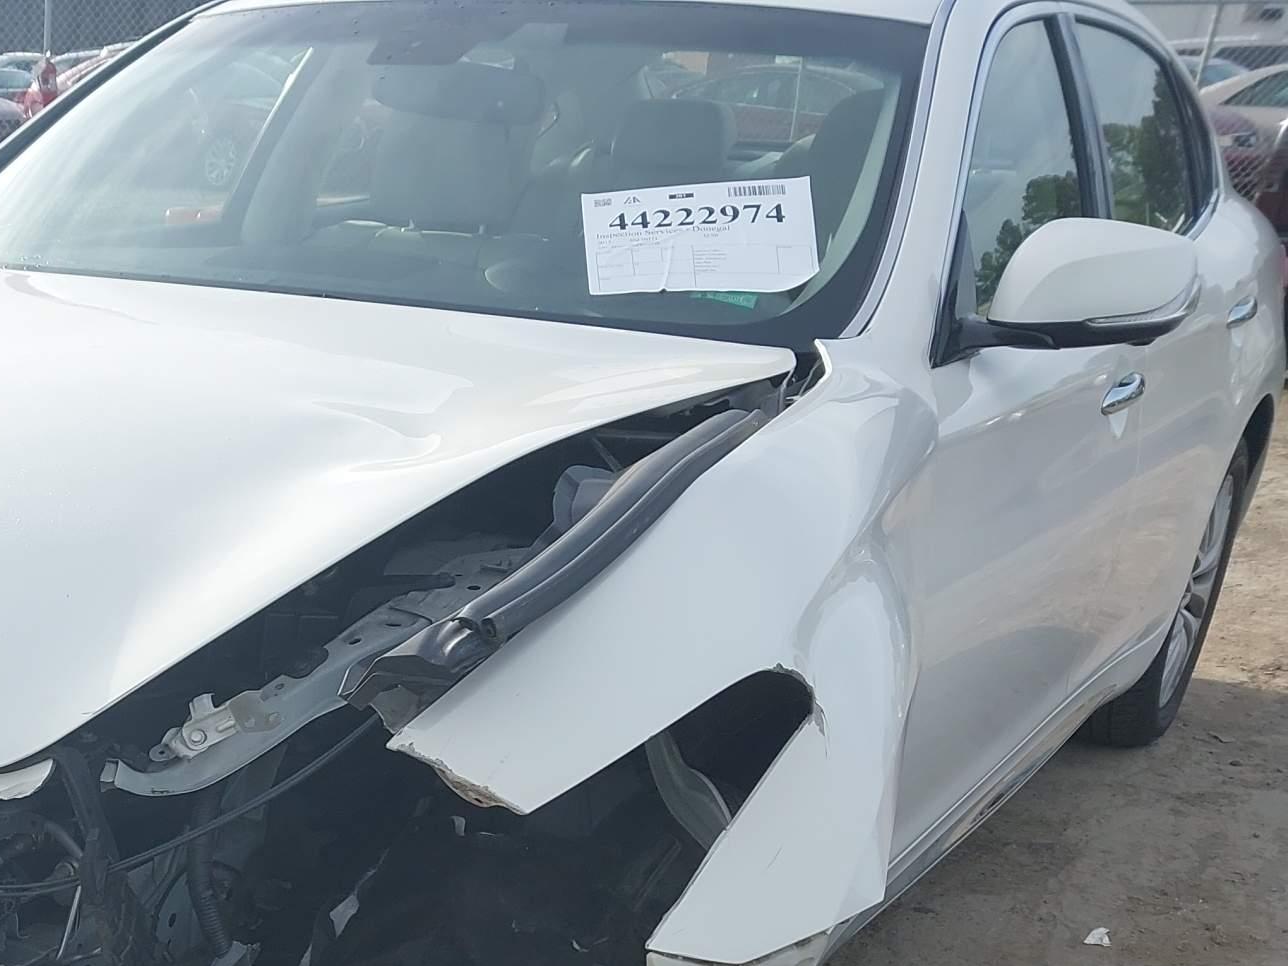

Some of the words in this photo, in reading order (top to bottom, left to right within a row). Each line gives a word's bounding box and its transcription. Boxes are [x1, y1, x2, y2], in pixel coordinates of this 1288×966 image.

[609, 203, 786, 230] 44222974
[596, 230, 643, 240] Inspection
[692, 225, 731, 233] Donegal
